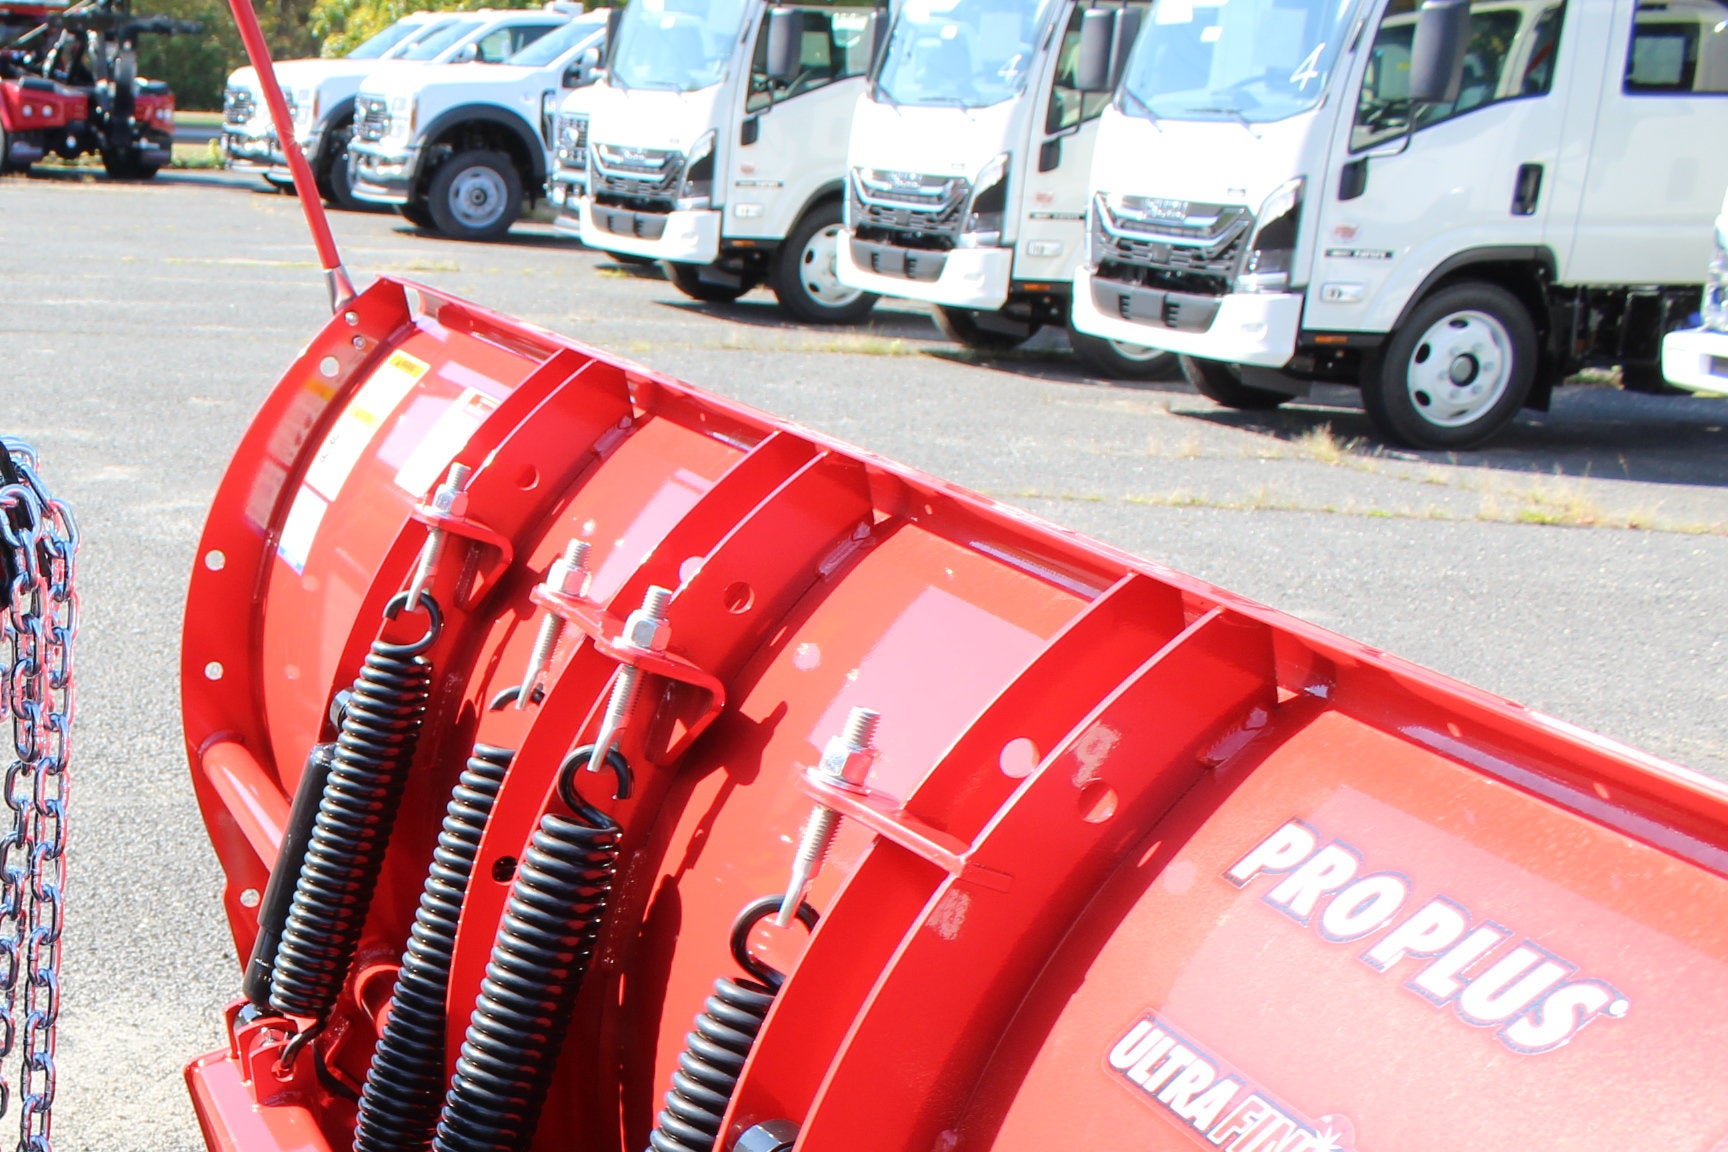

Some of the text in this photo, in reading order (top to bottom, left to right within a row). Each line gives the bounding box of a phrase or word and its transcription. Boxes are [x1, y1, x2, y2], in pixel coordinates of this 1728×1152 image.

[1289, 42, 1326, 91] 4
[1225, 818, 1617, 1053] PRO PLUS
